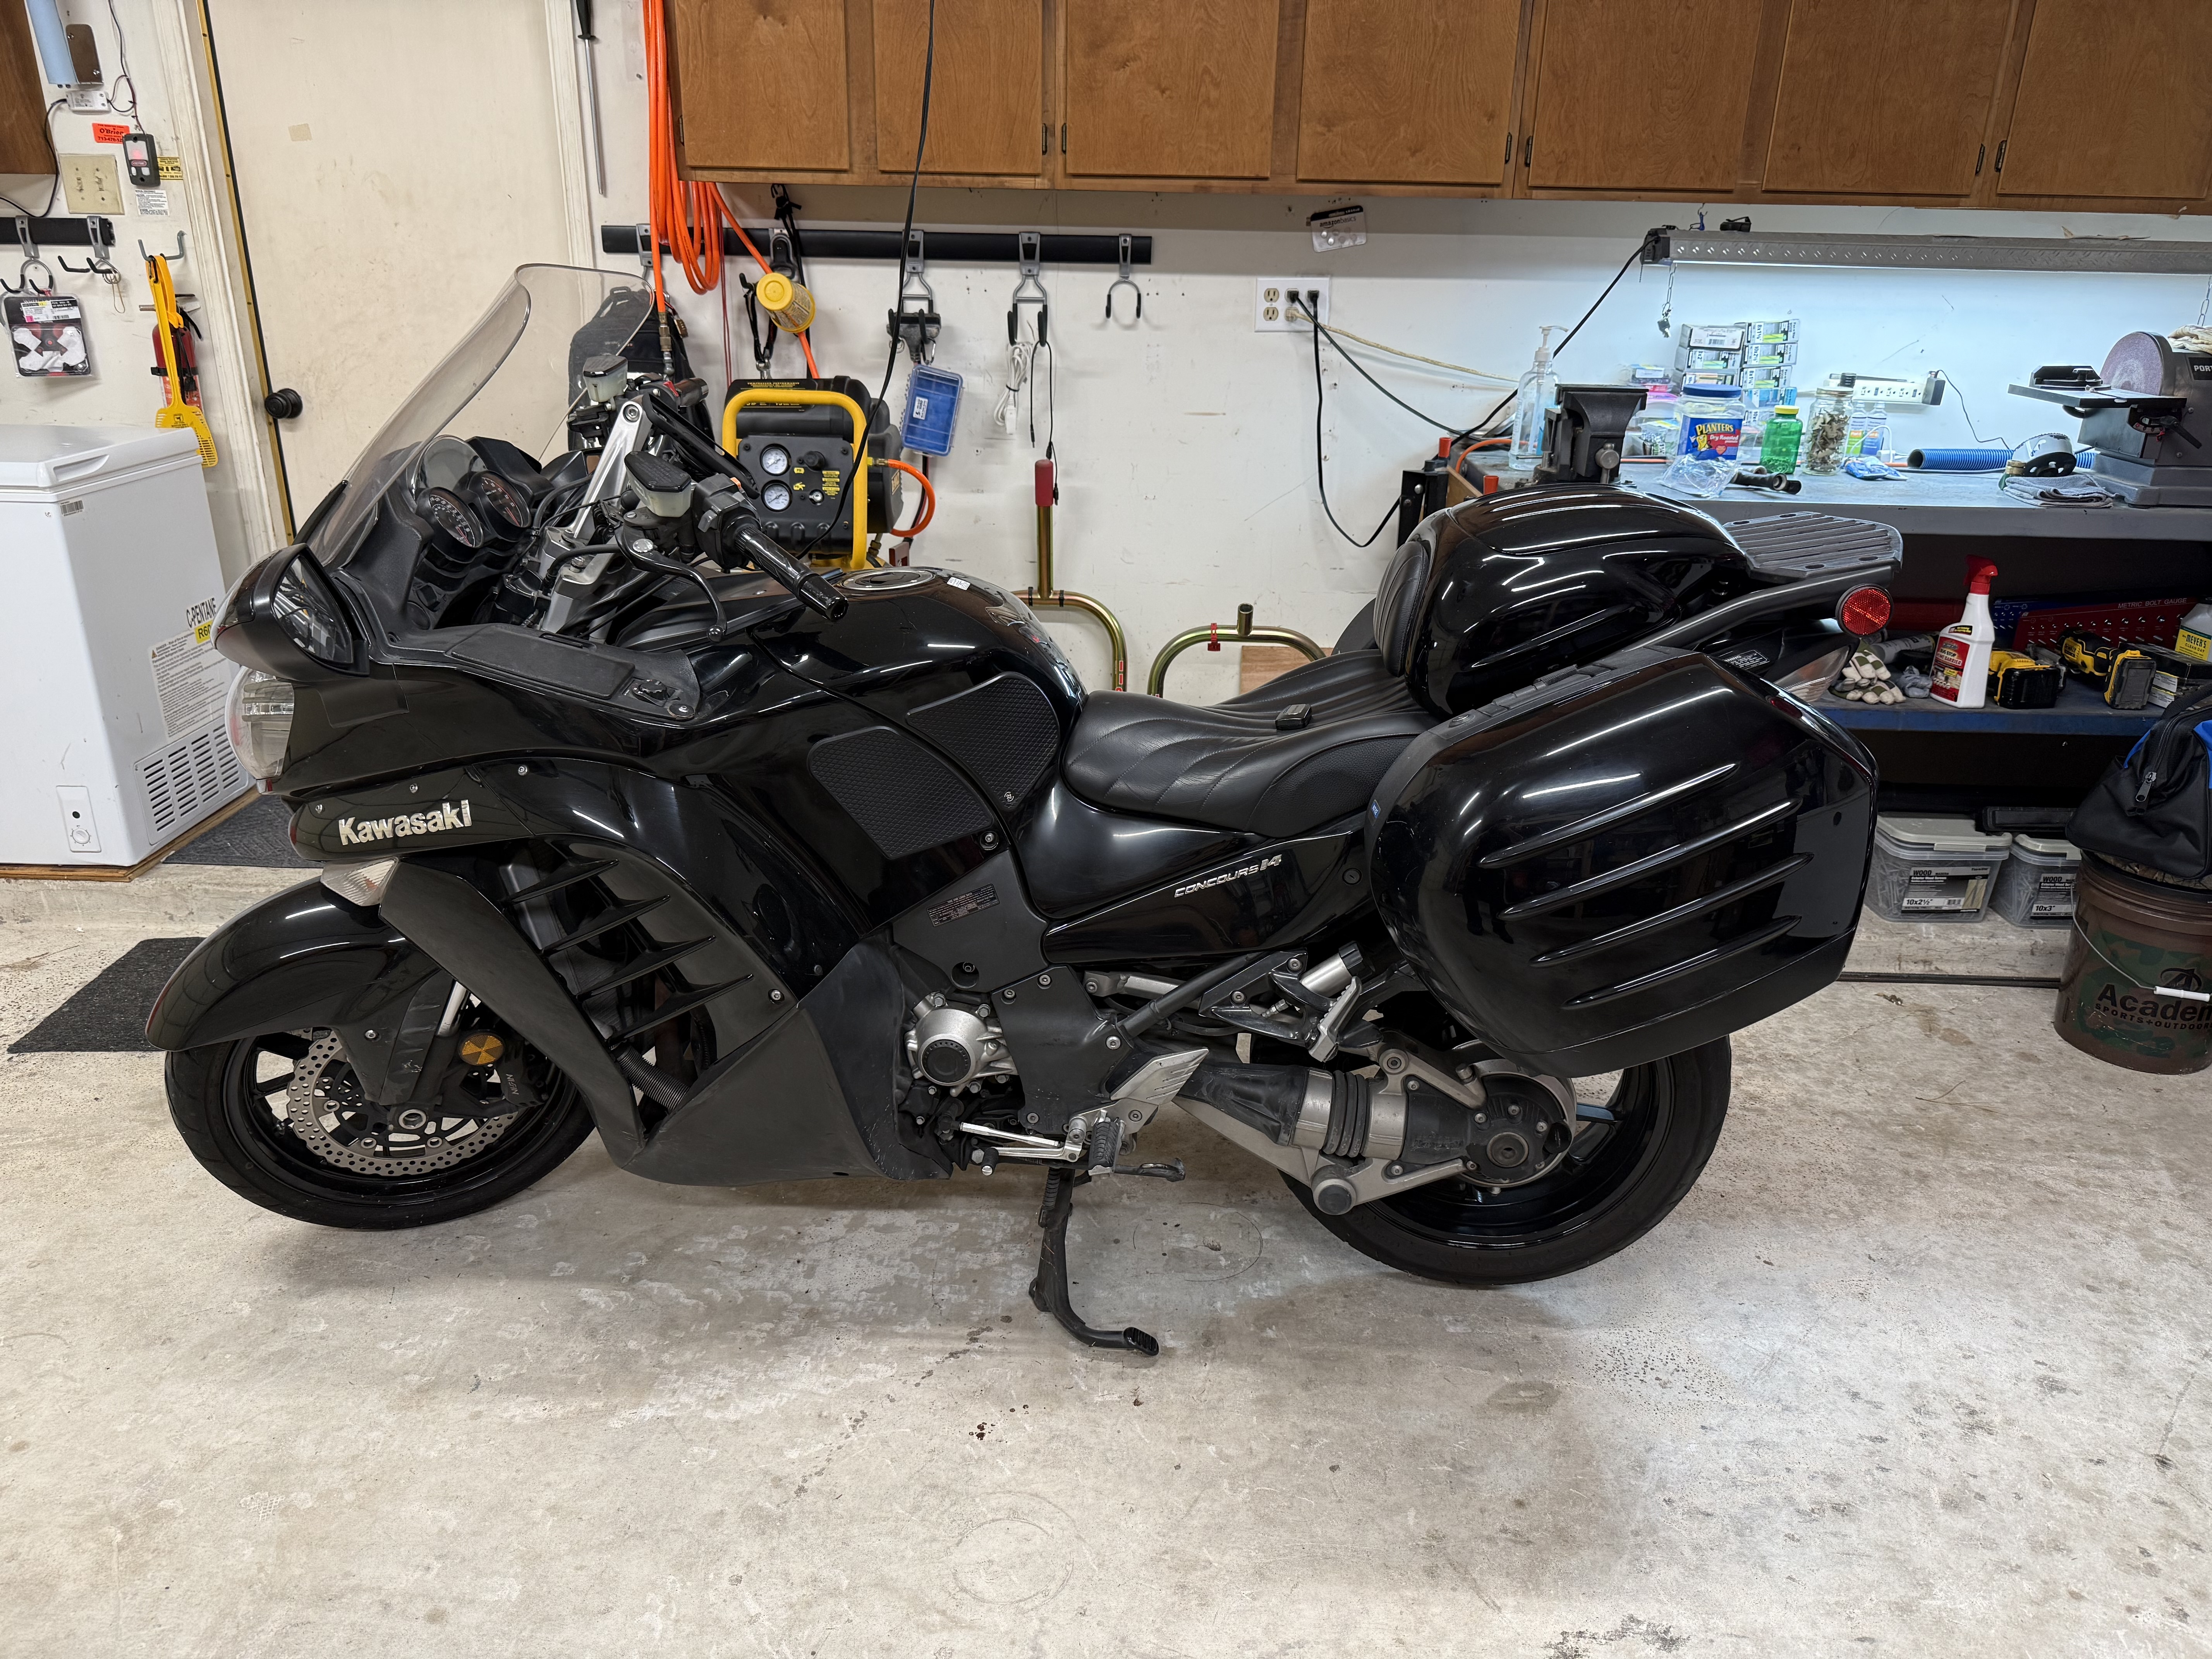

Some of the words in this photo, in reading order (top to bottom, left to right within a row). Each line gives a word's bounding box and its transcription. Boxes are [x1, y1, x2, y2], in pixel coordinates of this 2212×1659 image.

[1319, 216, 1356, 227] amazonbasics
[1696, 423, 1734, 435] PLANTERS
[186, 598, 216, 628] C-PENTANE
[198, 624, 211, 639] R60
[2186, 634, 2207, 648] MEYER'S
[1944, 656, 1961, 666] BARRIER
[338, 799, 472, 845] Kawasaki
[1174, 864, 1260, 898] CONCOURS
[1260, 854, 1282, 871] 14
[506, 1074, 519, 1095] NISSIN
